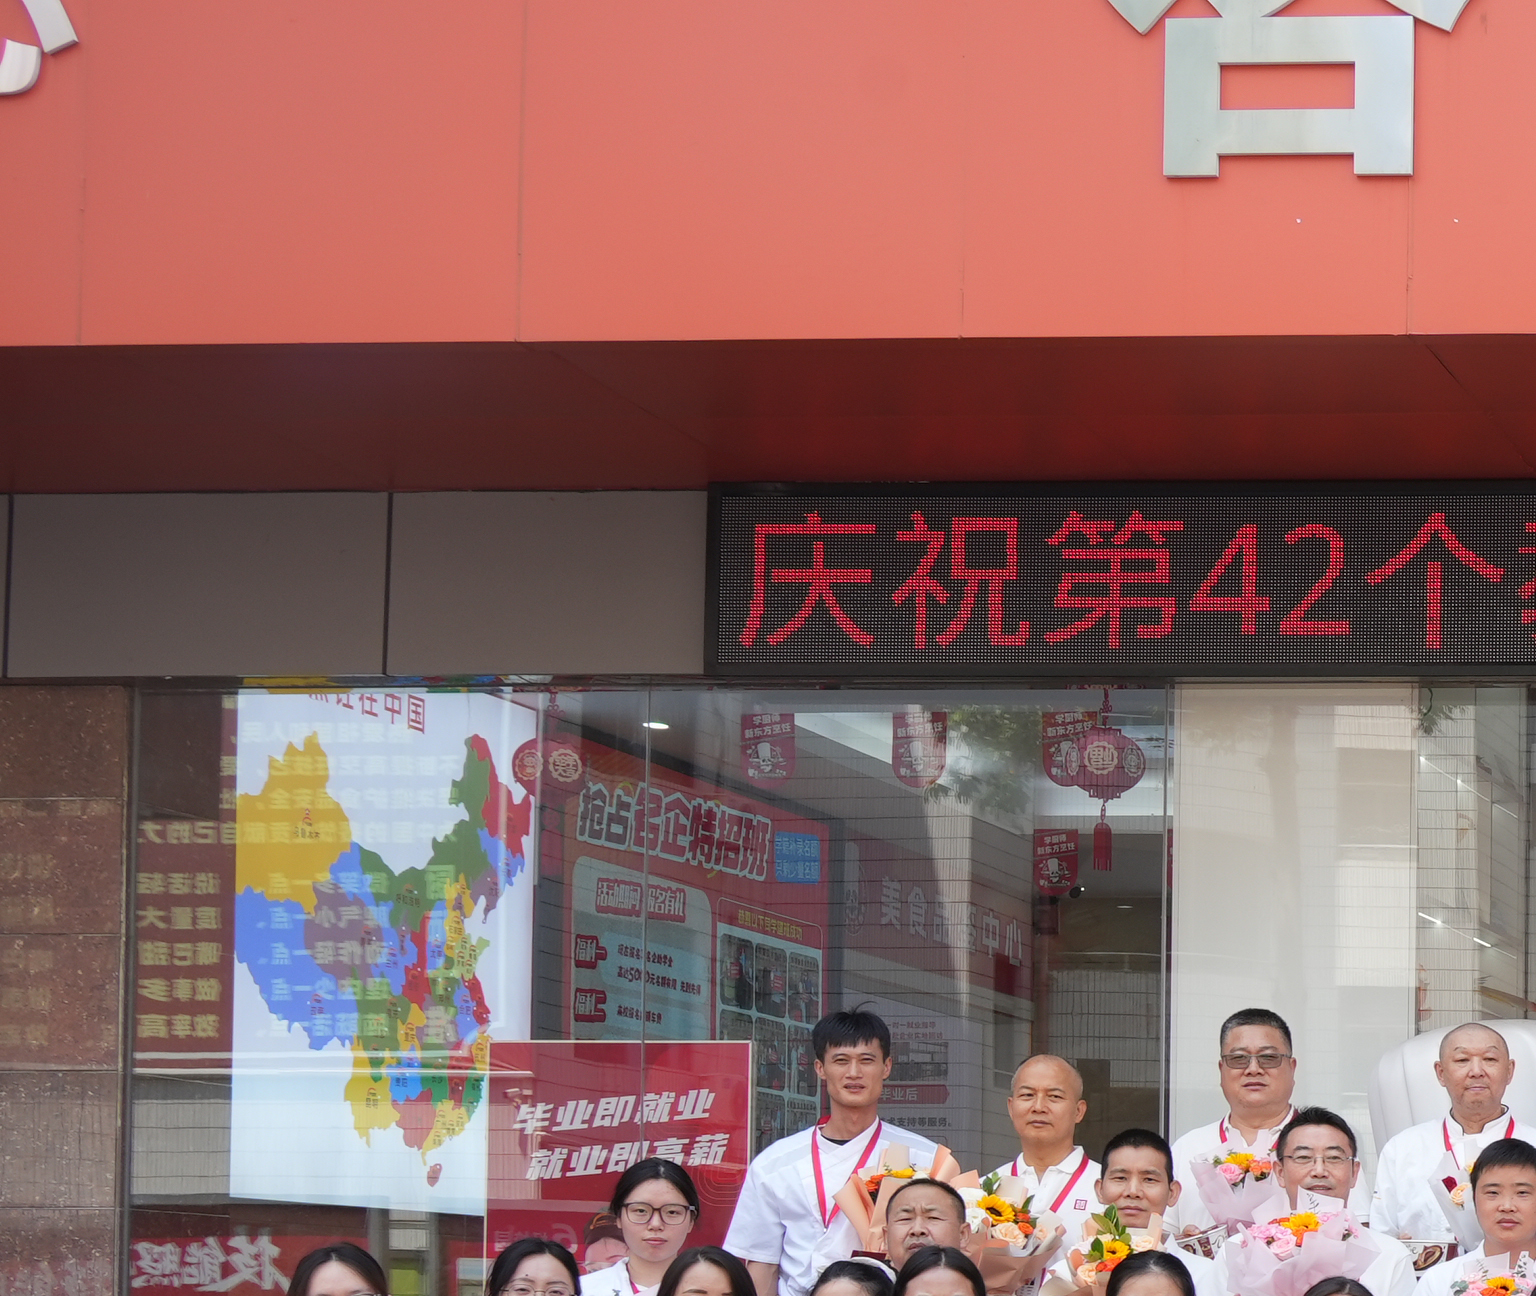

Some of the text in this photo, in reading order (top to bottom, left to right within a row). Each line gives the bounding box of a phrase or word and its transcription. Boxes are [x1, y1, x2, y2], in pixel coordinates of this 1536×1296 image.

[512, 1088, 716, 1135] 毕业即就业
[526, 1133, 730, 1181] 就业即高薪
